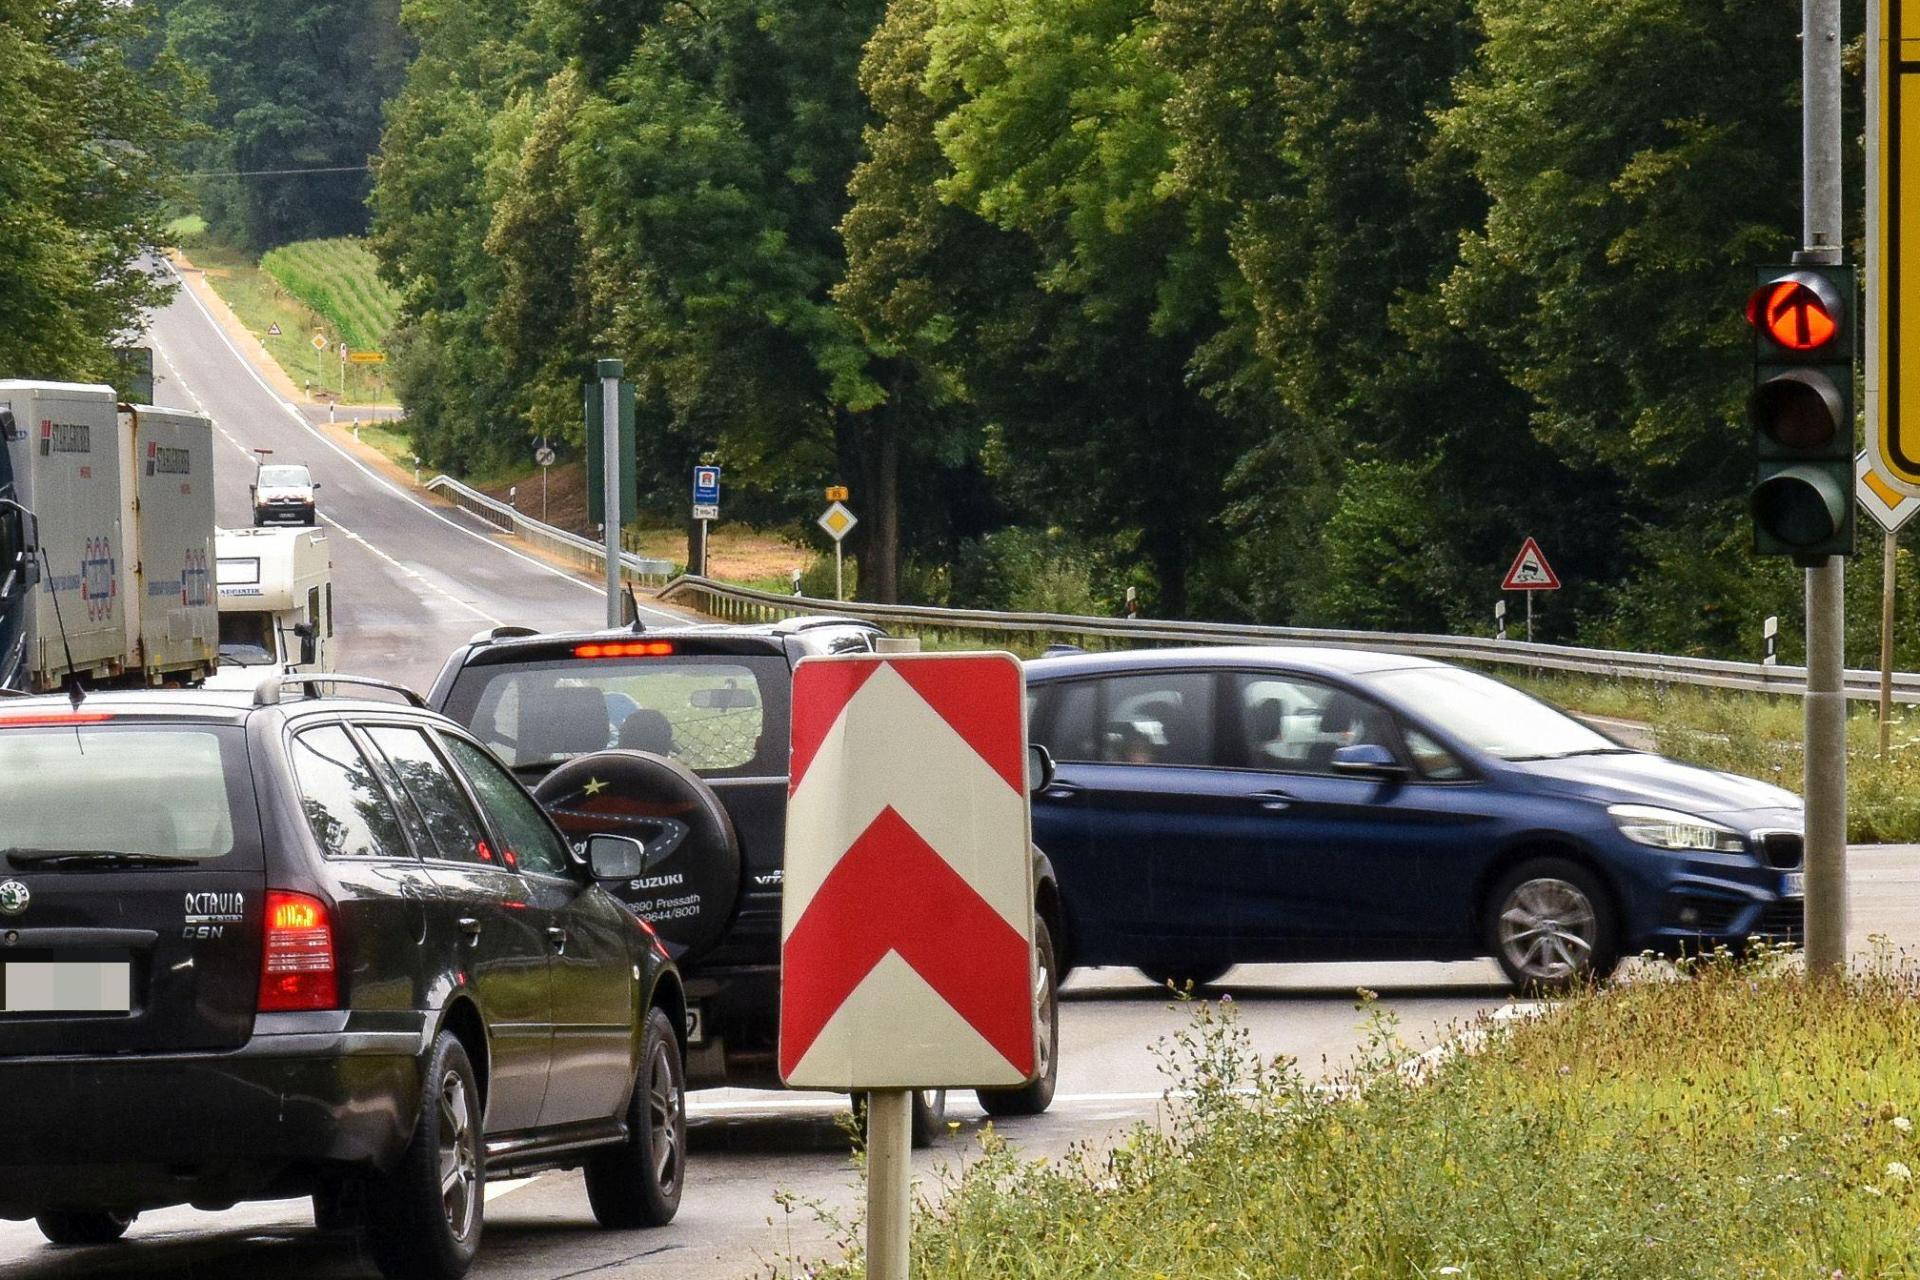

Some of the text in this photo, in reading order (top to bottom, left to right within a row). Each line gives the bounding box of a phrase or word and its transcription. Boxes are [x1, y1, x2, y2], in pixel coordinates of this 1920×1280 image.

[630, 873, 684, 890] SUZUKI
[185, 892, 244, 914] OCTAVIA
[656, 893, 701, 908] Pressath
[182, 925, 224, 939] CSN
